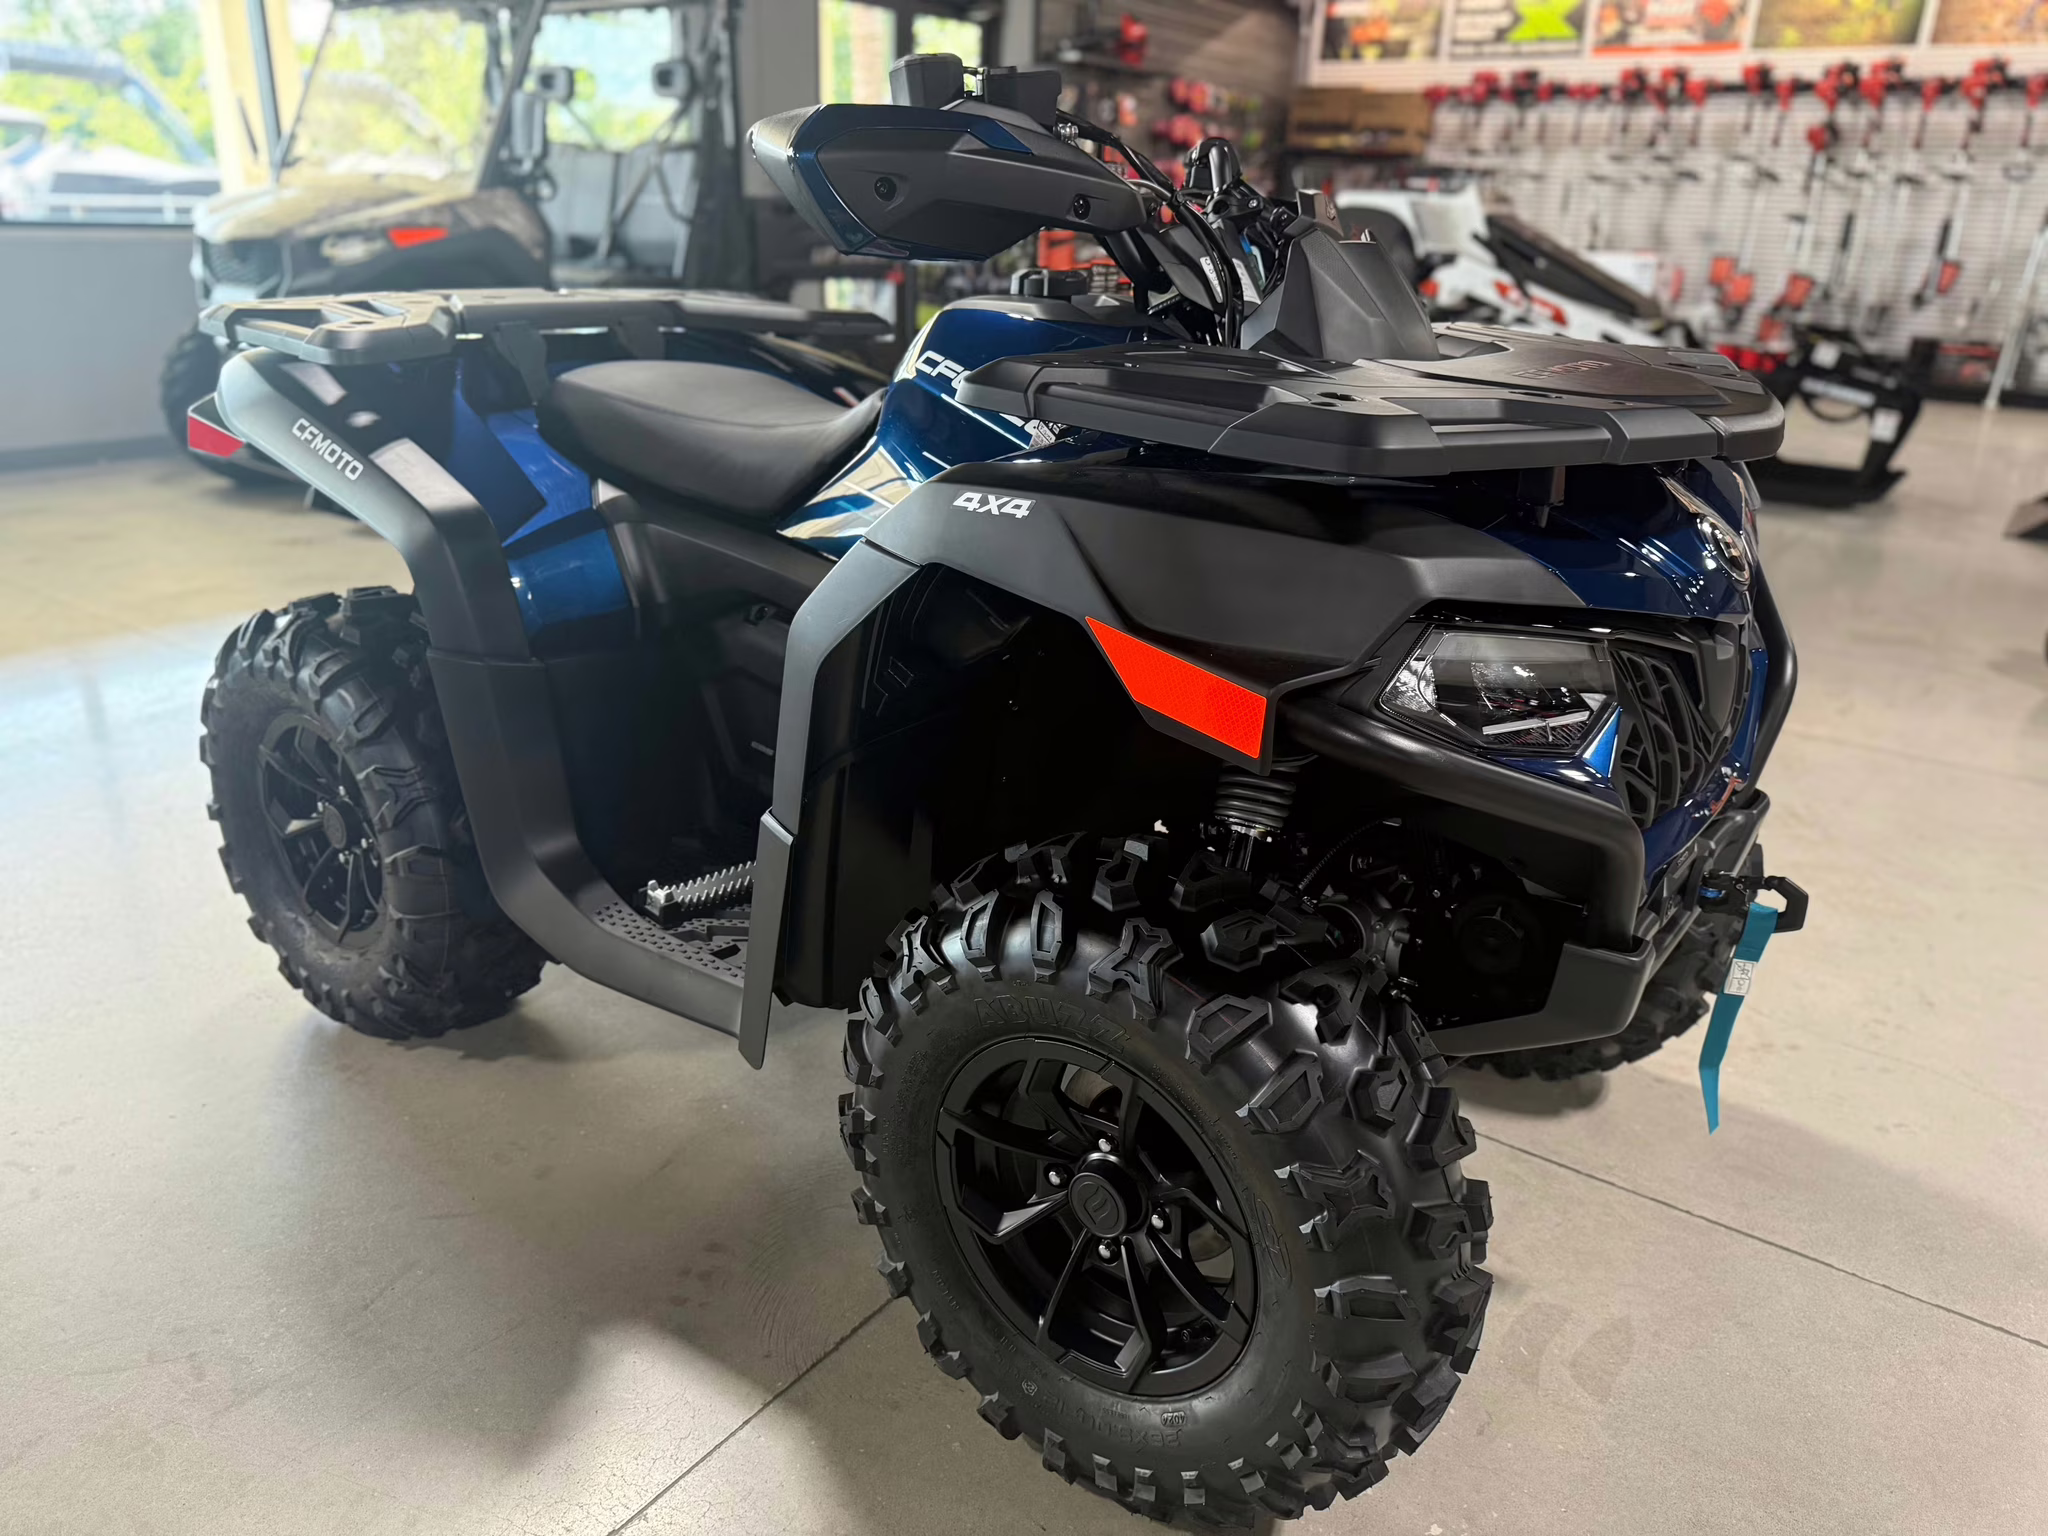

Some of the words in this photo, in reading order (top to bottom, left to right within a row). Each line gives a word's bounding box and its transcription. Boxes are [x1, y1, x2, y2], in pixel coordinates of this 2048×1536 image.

[291, 417, 364, 481] CFMOTO
[953, 492, 1032, 519] 4X4
[974, 994, 1128, 1054] ABUZZ
